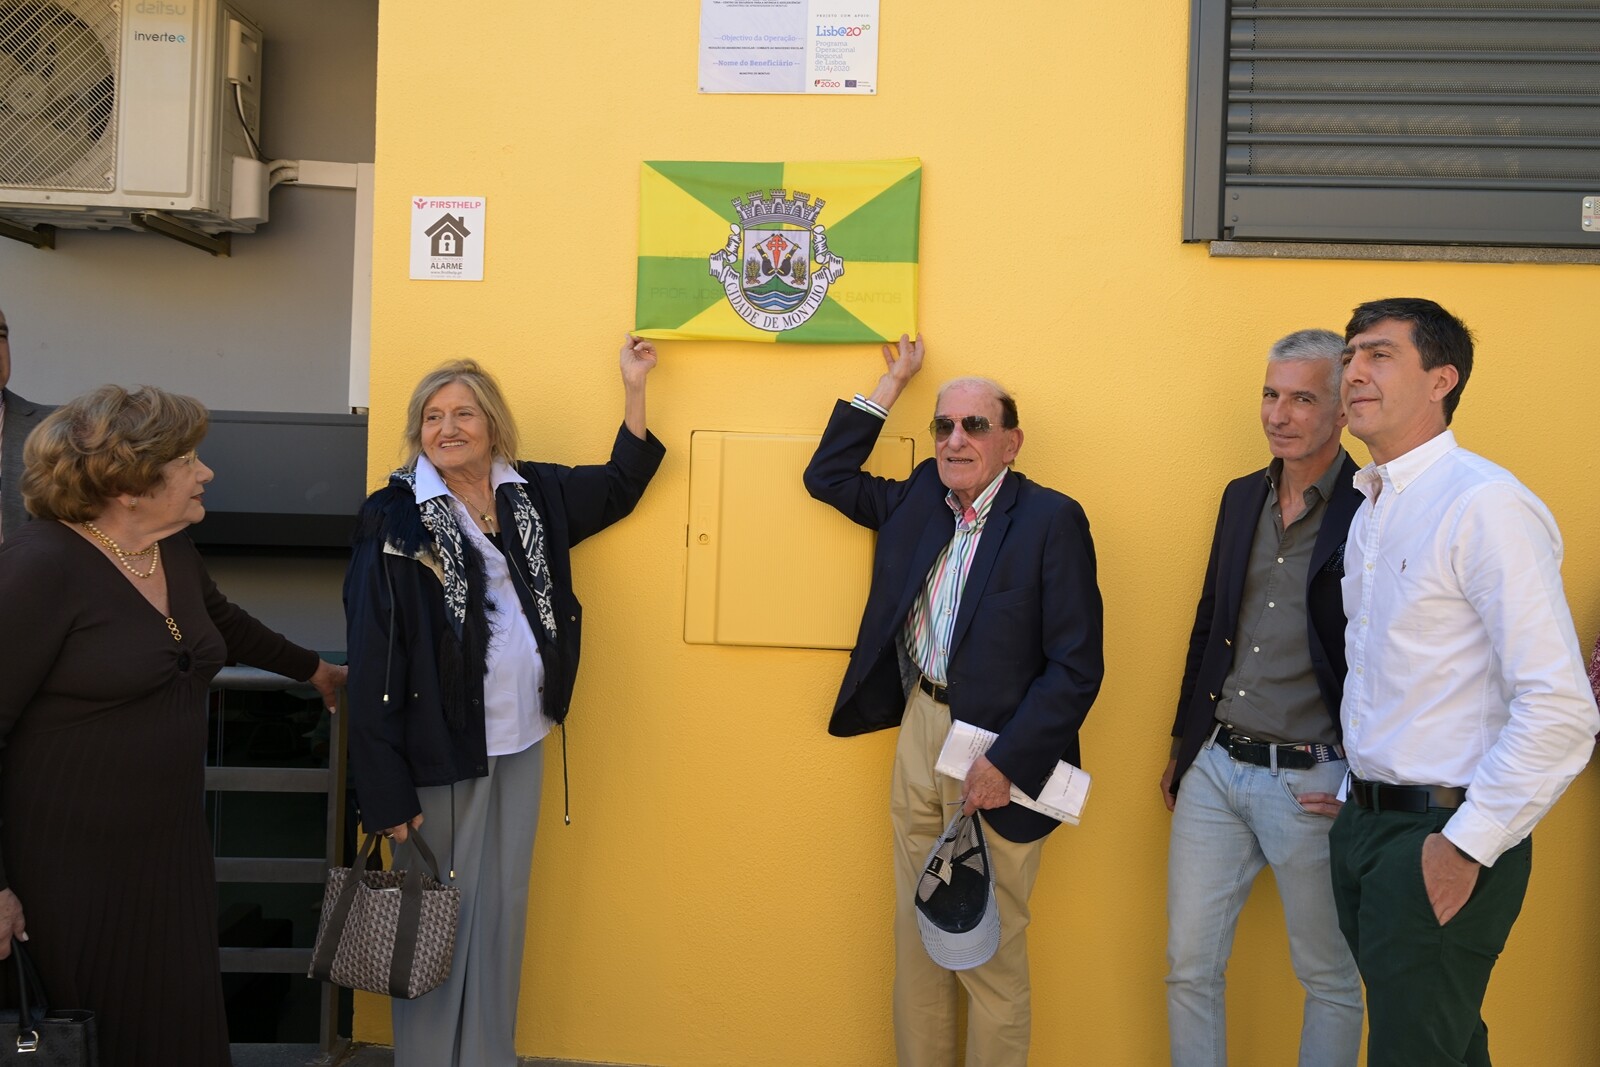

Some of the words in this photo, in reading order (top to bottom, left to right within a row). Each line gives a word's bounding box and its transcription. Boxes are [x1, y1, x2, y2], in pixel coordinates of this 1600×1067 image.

[815, 65, 850, 73] 2014/2020
[430, 201, 481, 209] FIRSTHELP
[430, 262, 463, 270] ALARME
[725, 282, 760, 324] CIDADE
[763, 316, 779, 329] DE
[782, 284, 825, 328] MONTIJO
